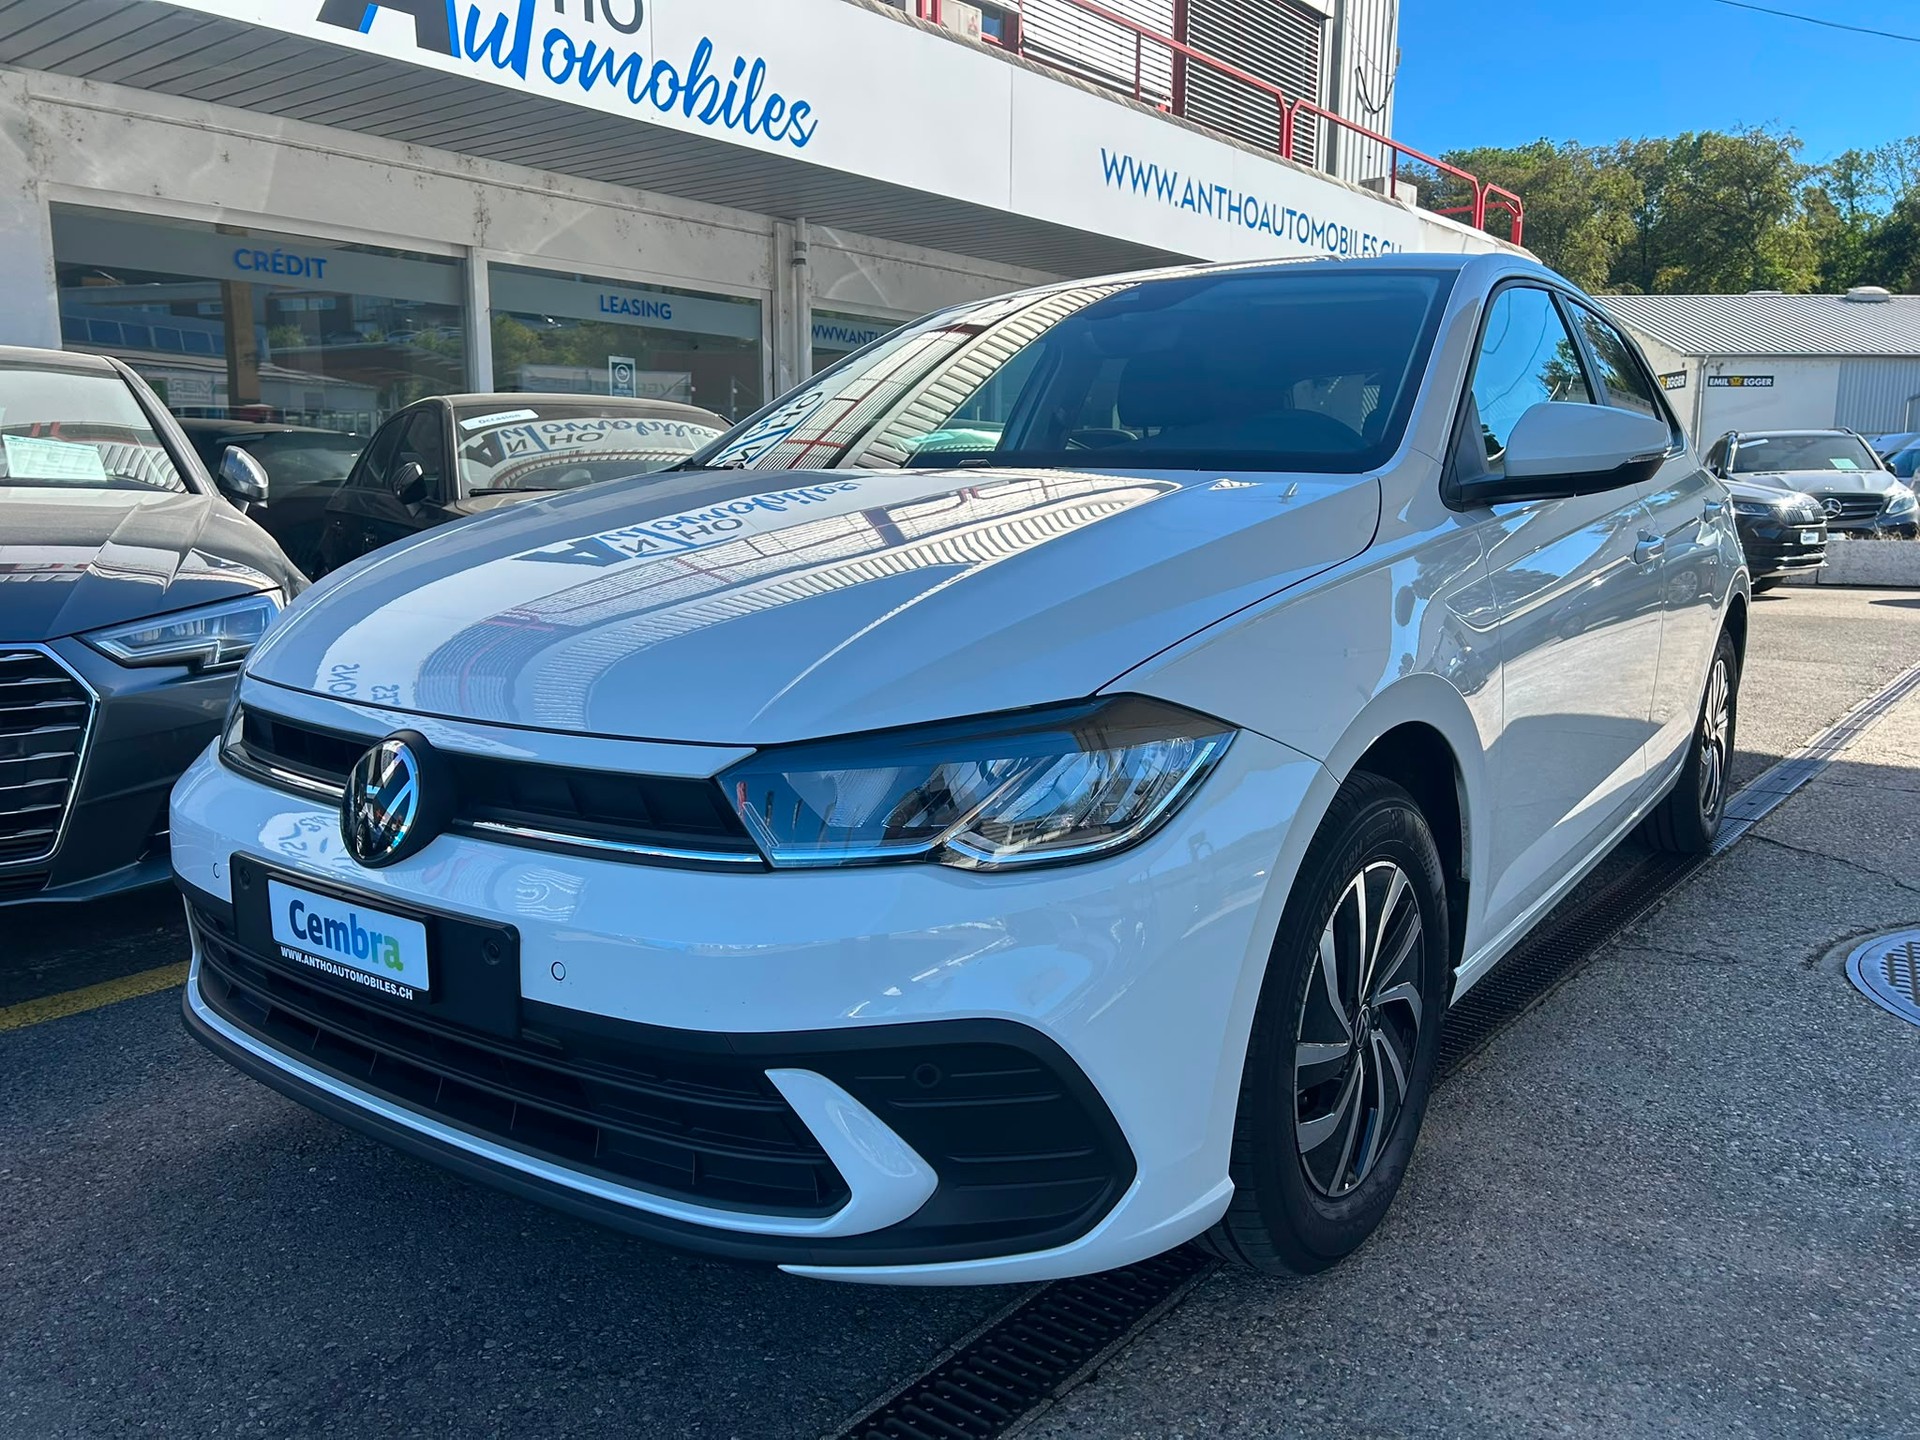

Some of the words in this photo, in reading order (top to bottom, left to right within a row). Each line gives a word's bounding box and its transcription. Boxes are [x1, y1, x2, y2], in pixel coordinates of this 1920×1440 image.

[316, 0, 818, 147] uomobiles
[234, 248, 327, 279] CRÉDIT
[600, 295, 672, 319] LEASING
[1709, 378, 1729, 387] EMIL
[1743, 378, 1772, 387] EGGER
[289, 899, 404, 971] Cembra
[280, 946, 413, 1000] WWW.ANTHOAUTOMOBILES.CH
